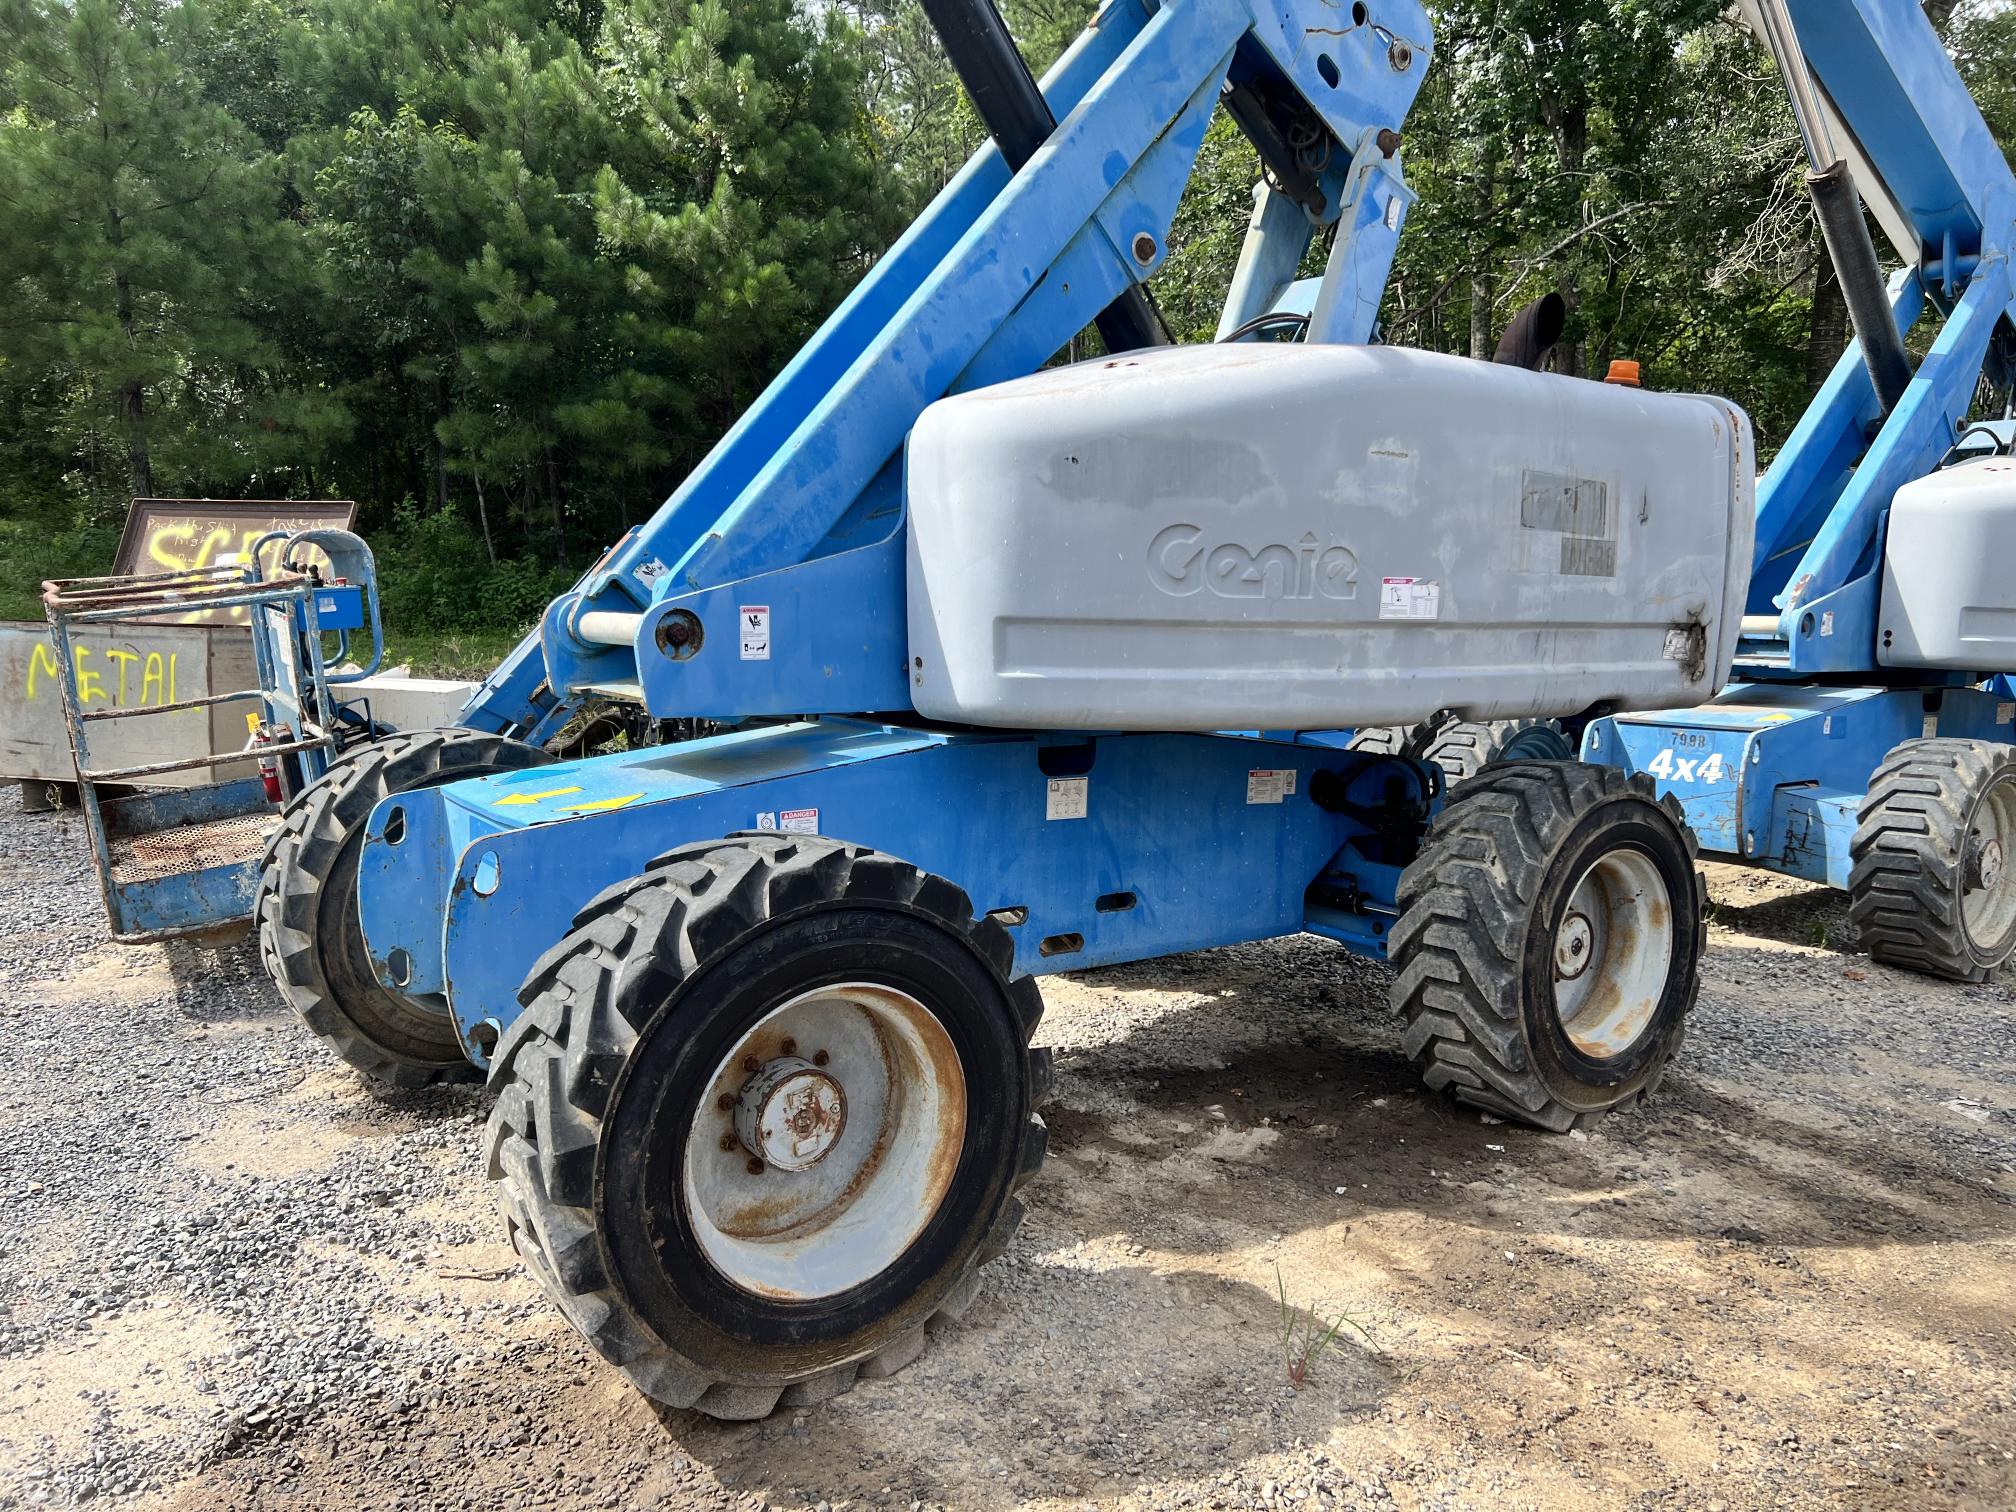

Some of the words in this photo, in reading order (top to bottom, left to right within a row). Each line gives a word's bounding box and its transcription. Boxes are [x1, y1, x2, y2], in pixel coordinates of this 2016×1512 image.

[1147, 523, 1357, 600] Genie
[1671, 732, 1705, 748] 7998
[1647, 748, 1724, 784] 4x4
